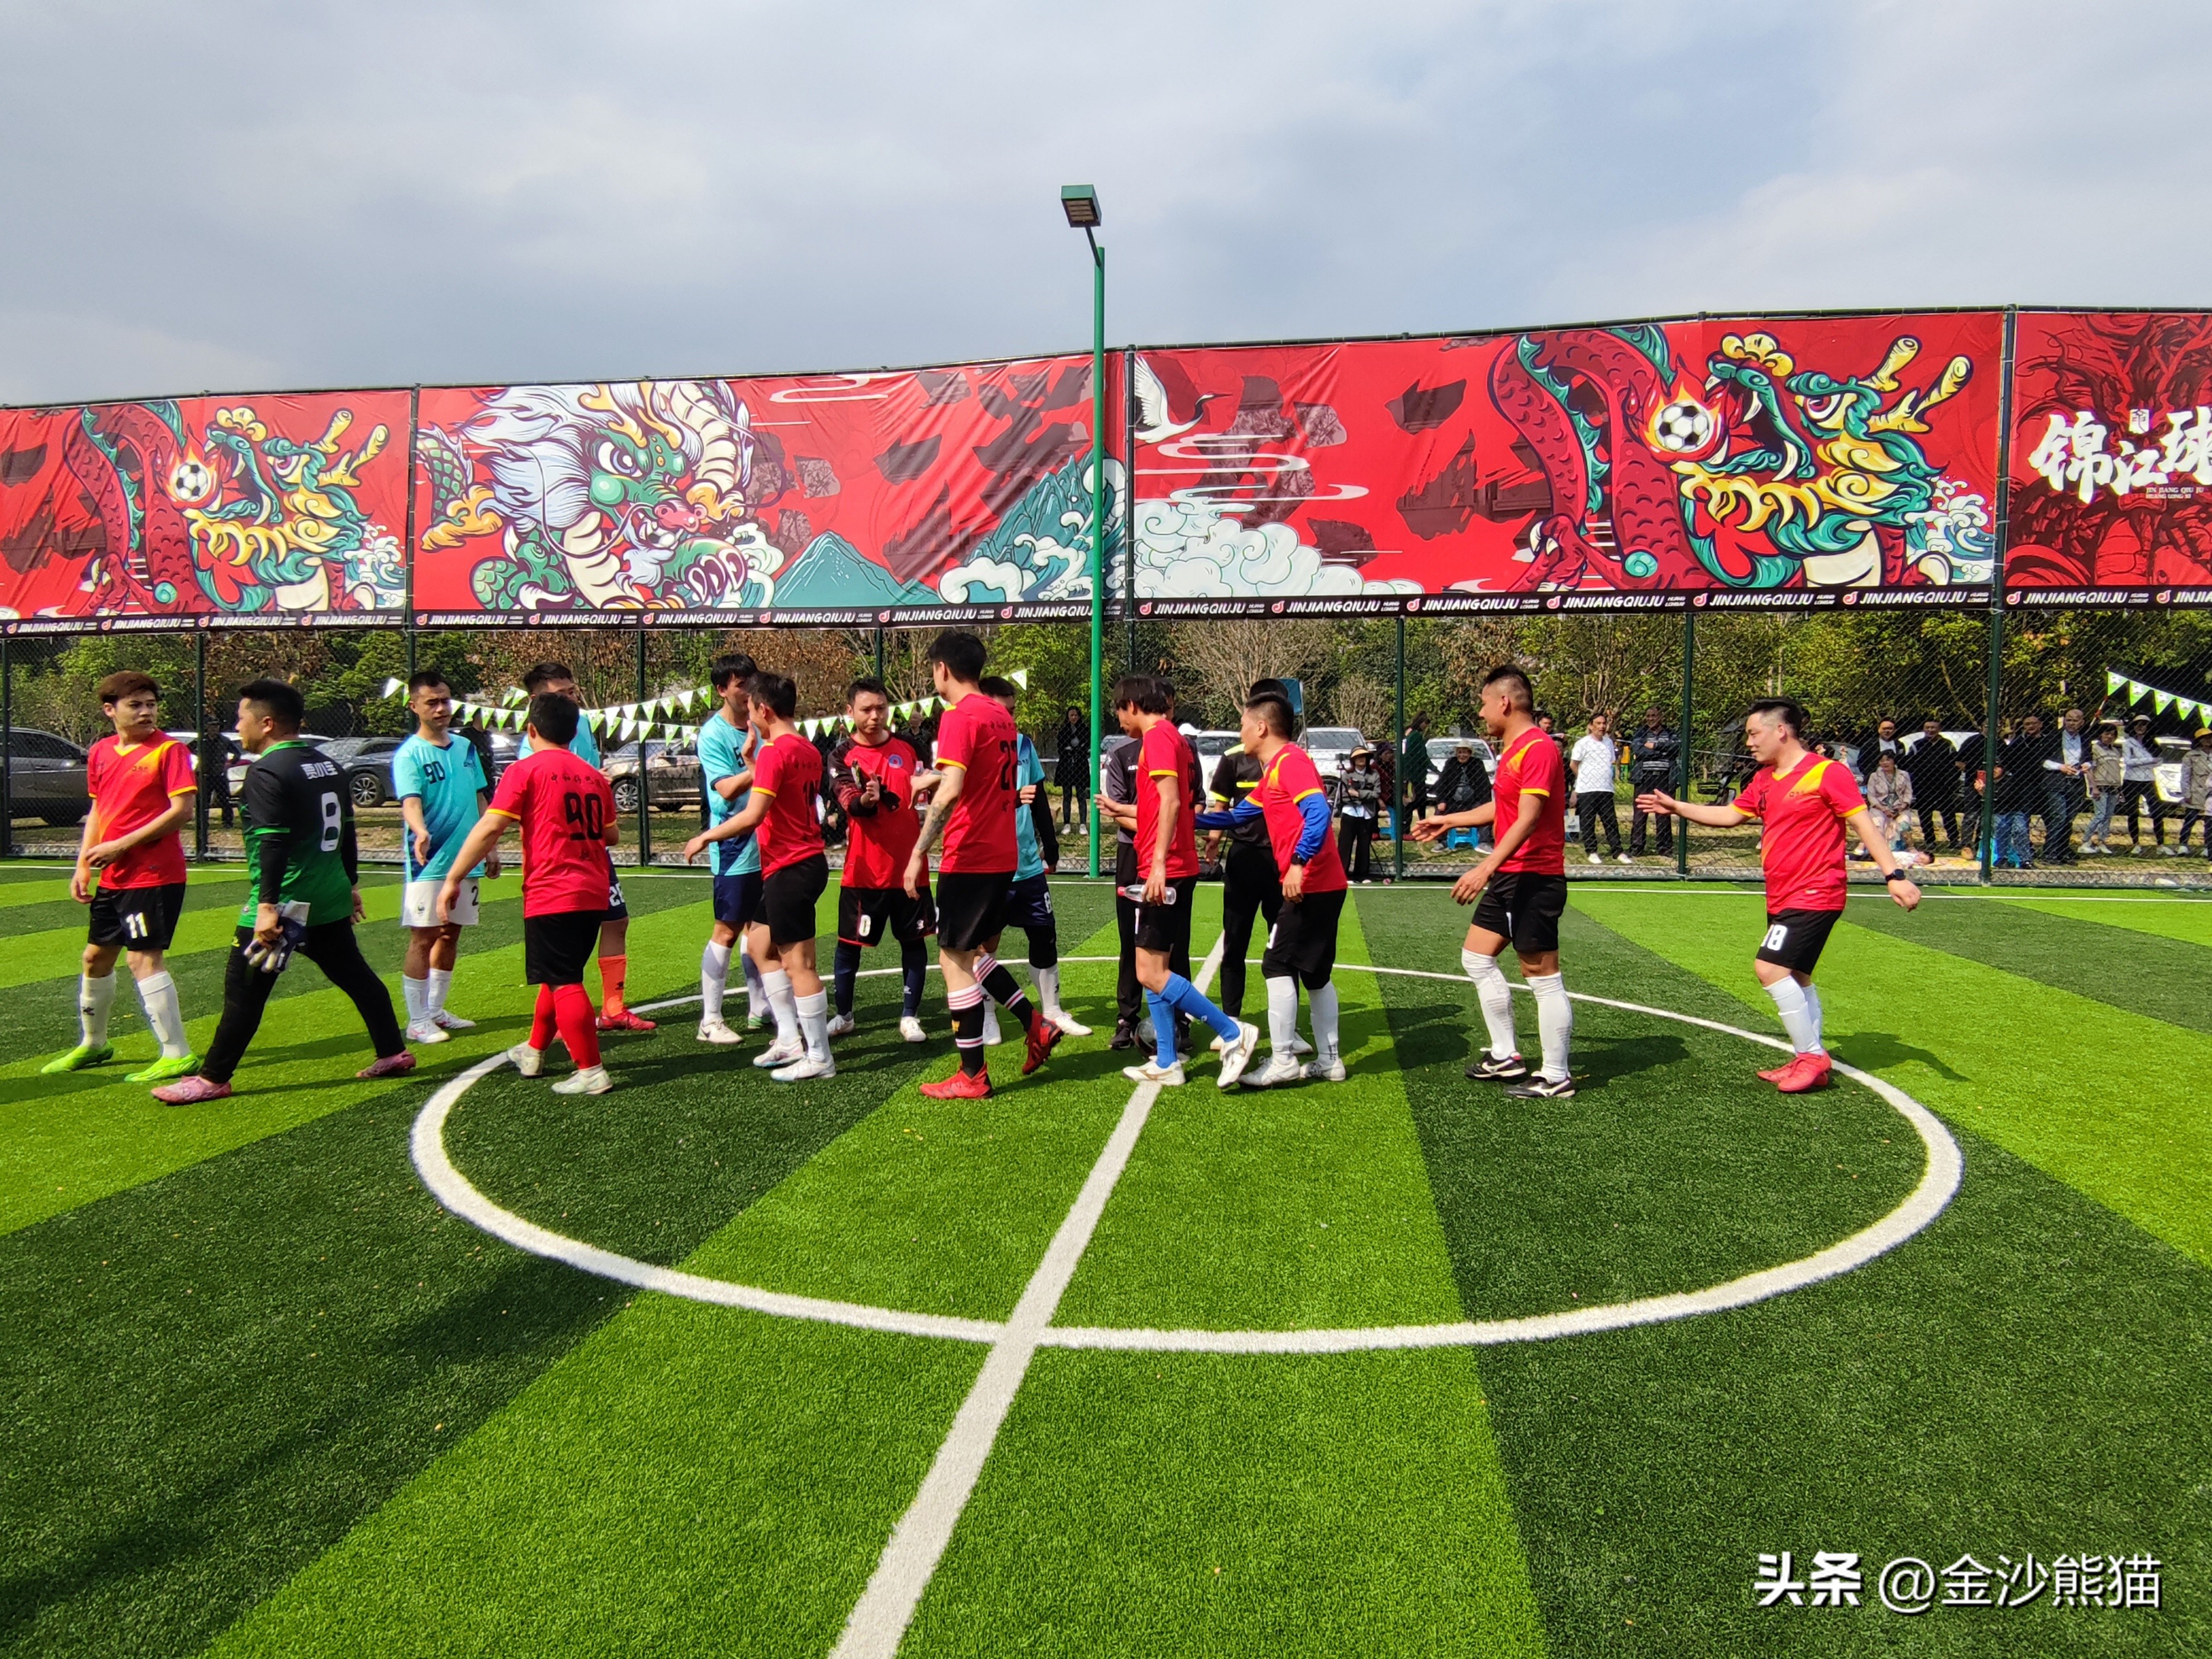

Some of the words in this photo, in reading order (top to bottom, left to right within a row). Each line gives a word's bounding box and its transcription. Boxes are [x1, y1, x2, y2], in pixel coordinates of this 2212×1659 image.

[1563, 596, 1665, 608] JINJIANGQIUJU
[1710, 594, 1814, 606] JINJIANGQIUJU
[1860, 592, 1968, 604] JINJIANGQIUJU
[2023, 592, 2127, 604] JINJIANGQIUJU
[1154, 603, 1247, 614] JINJIANGQIUJU
[1286, 601, 1380, 613] JINJIANGQIUJU
[1422, 599, 1520, 611] JINJIANGQIUJU
[773, 612, 855, 623] JINJIANGQIUJU
[893, 609, 978, 622] JINJIANGQIUJU
[1015, 606, 1093, 618] JINJIANGQIUJ
[430, 615, 508, 625] JINJIANGQIUJU
[542, 614, 621, 625] JINJIANGQIUJU
[656, 613, 738, 624] JINJIANGQIUJU
[422, 761, 446, 785] 90
[320, 792, 342, 852] 8
[563, 792, 603, 840] 90
[126, 912, 148, 939] 11
